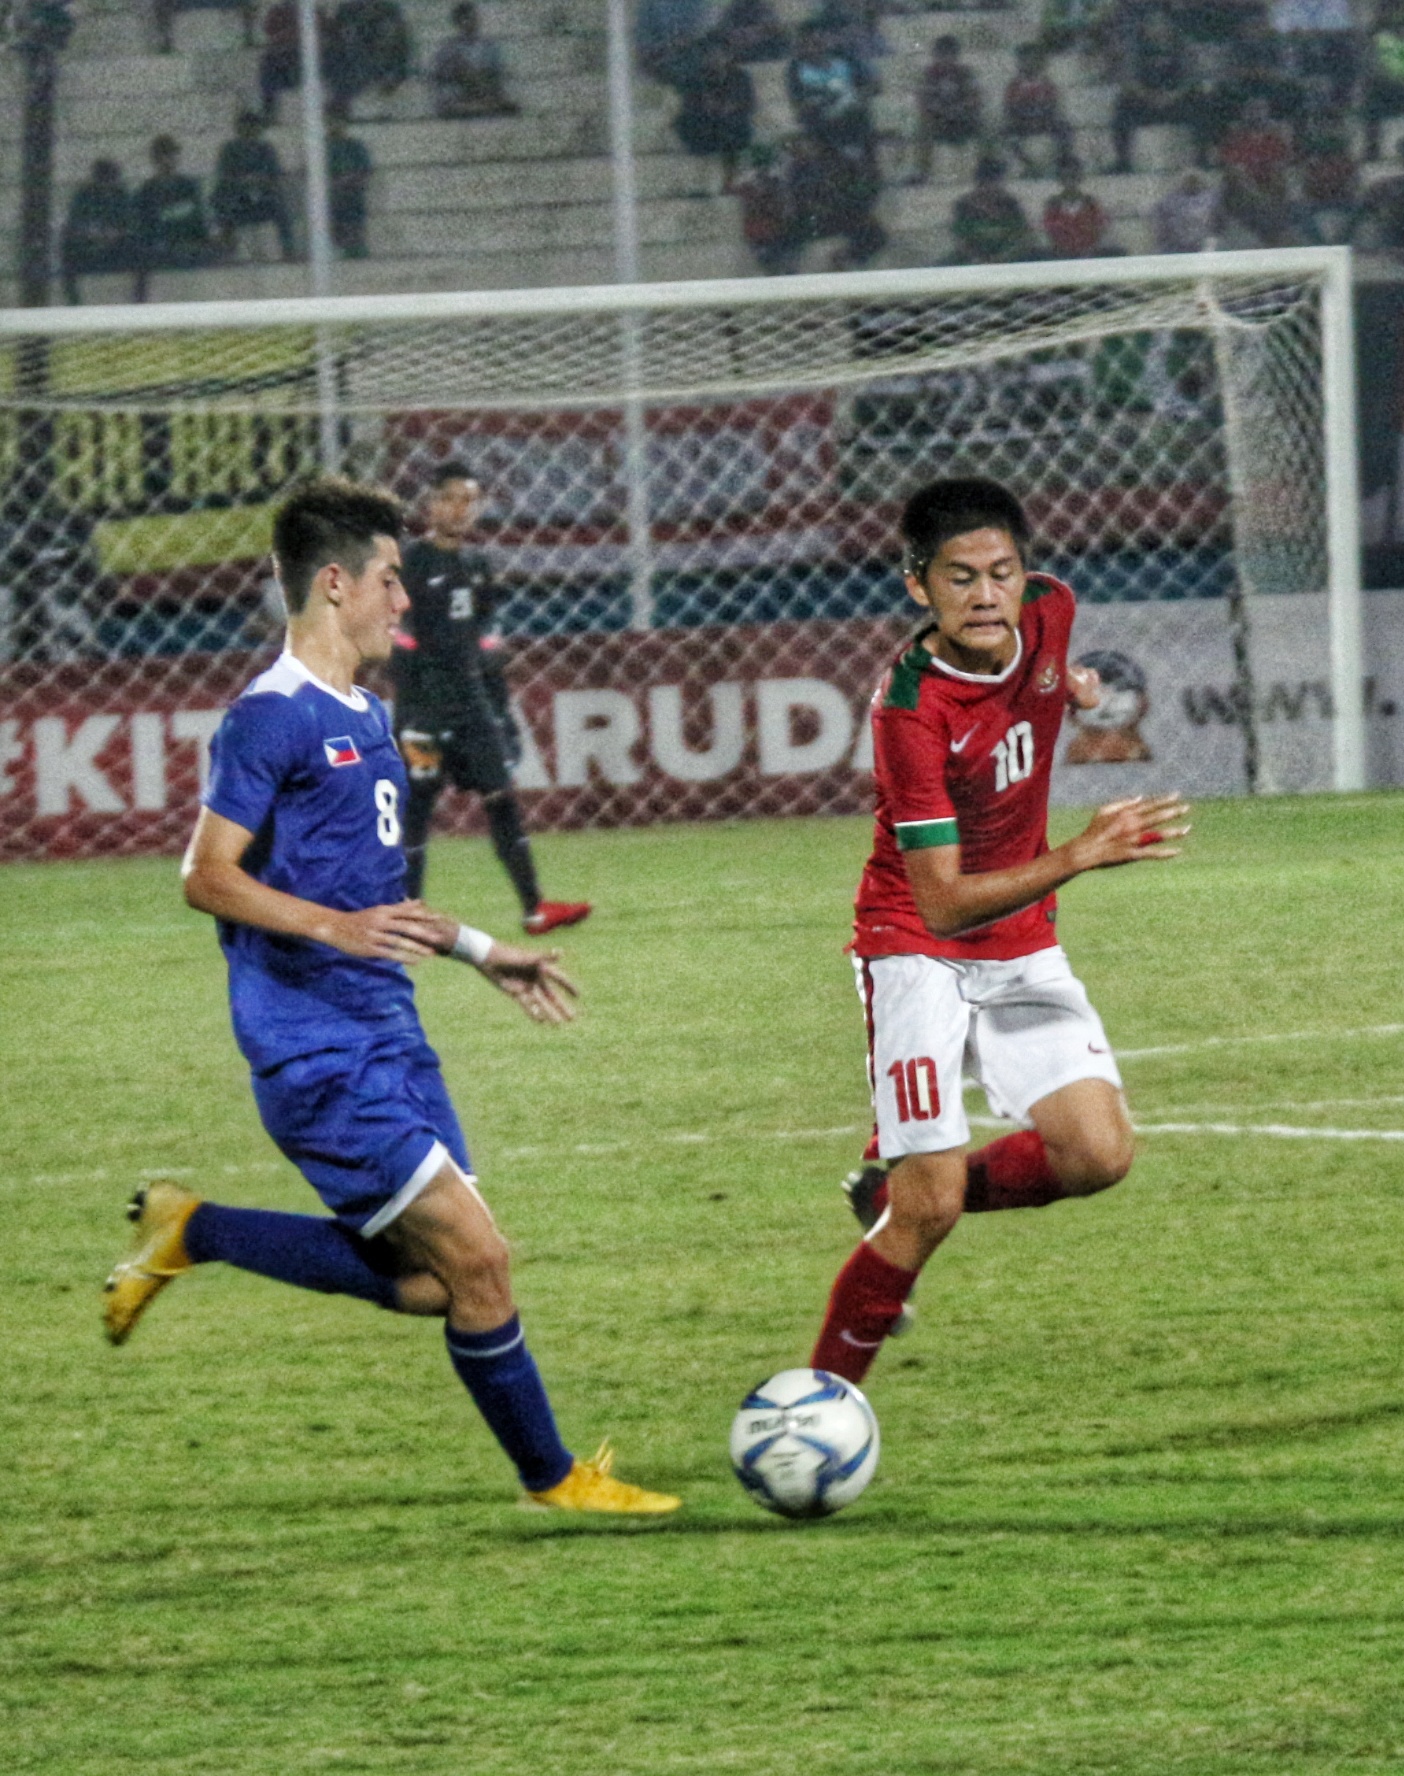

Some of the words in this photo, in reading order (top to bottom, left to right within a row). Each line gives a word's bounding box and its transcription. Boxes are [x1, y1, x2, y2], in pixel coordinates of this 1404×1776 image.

[989, 720, 1034, 792] 10
[374, 778, 400, 847] 8
[887, 1056, 941, 1123] 10
